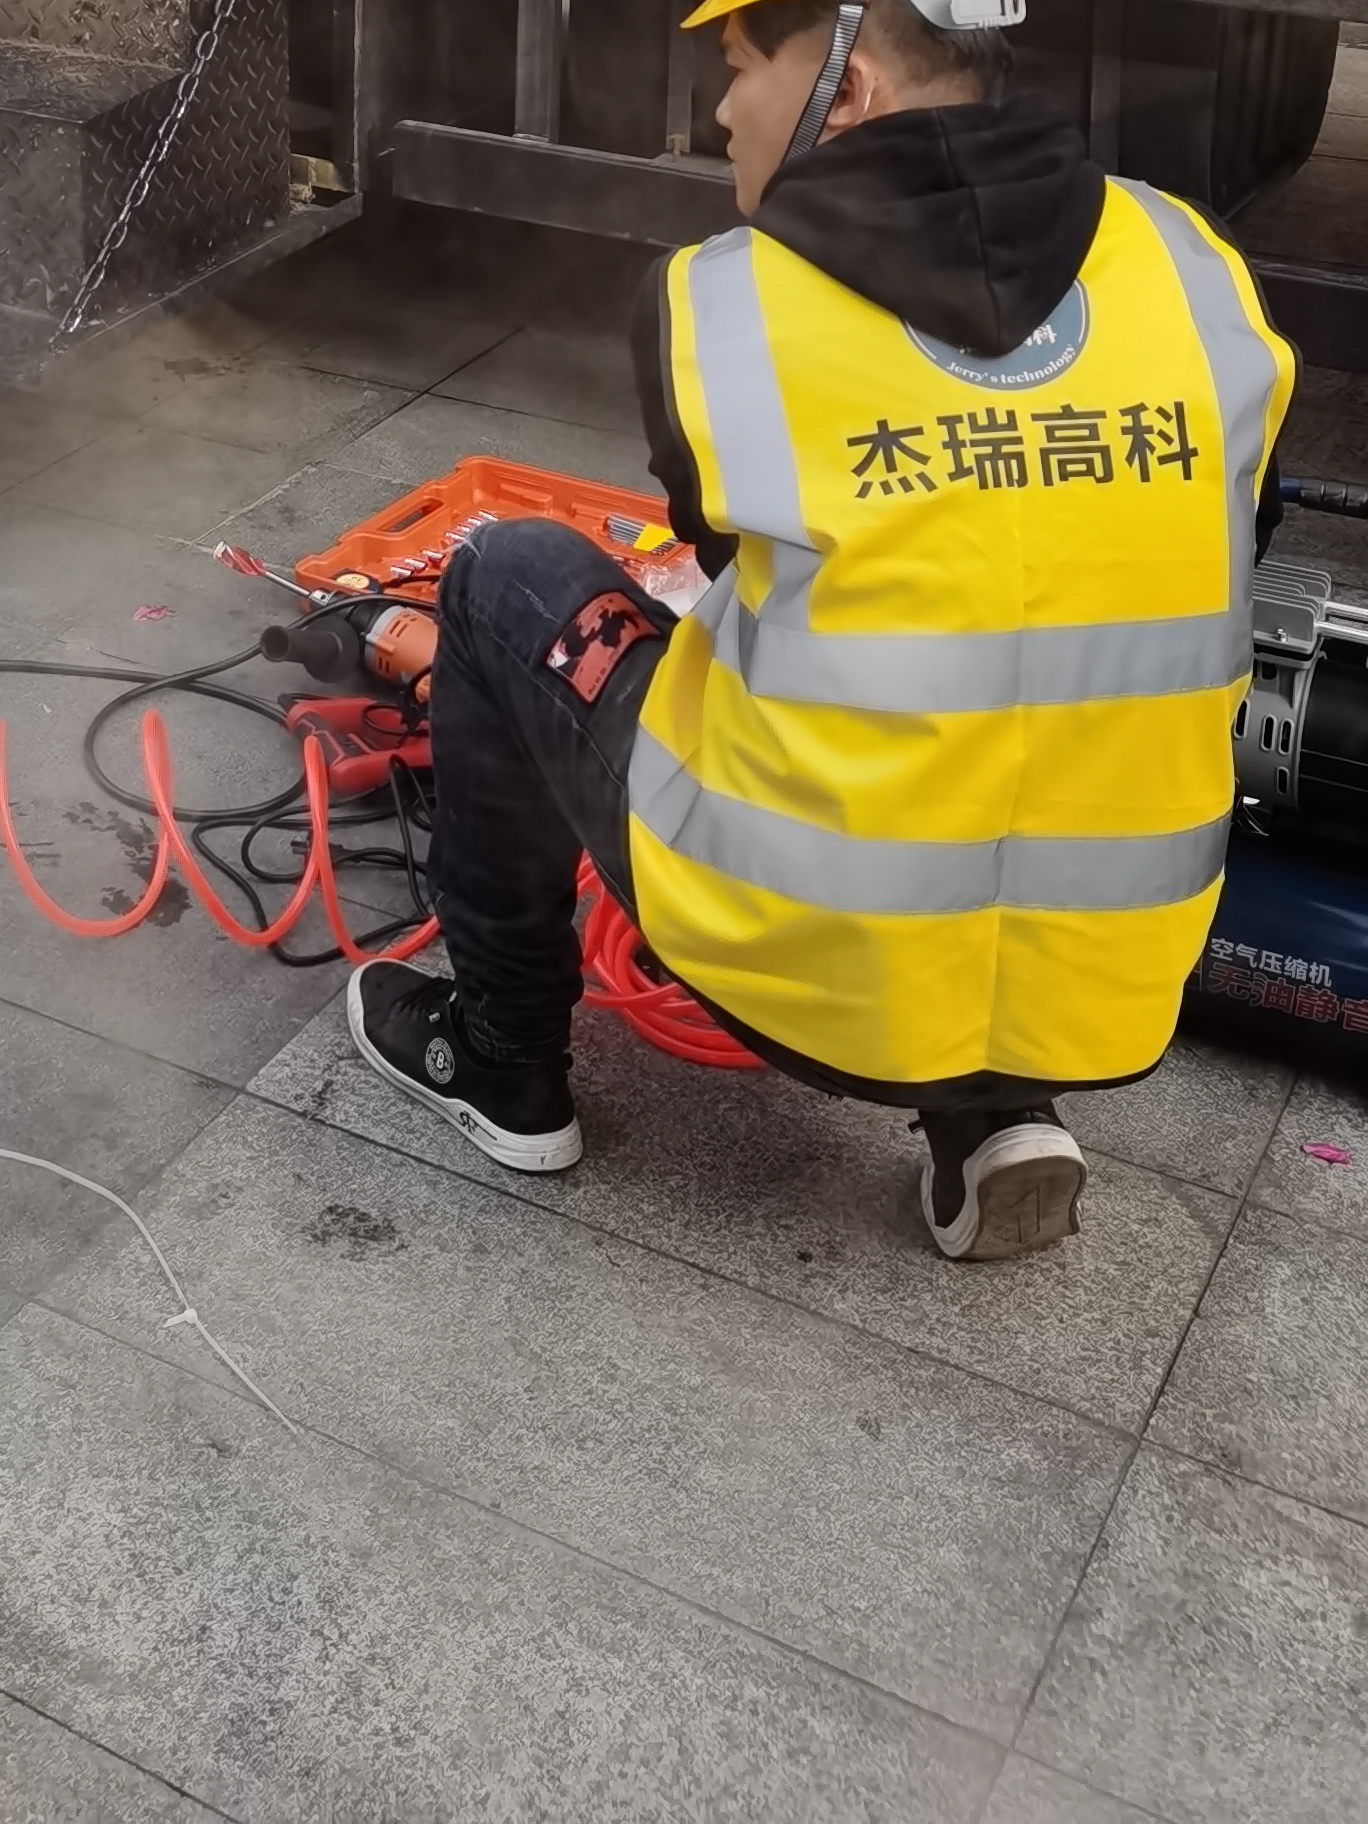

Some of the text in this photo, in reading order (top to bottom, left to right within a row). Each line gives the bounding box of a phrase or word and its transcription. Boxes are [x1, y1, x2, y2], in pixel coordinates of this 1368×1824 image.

[1001, 344, 1077, 385] technology
[846, 400, 1200, 500] 杰瑞高科
[1209, 937, 1333, 988] 空气压缩机
